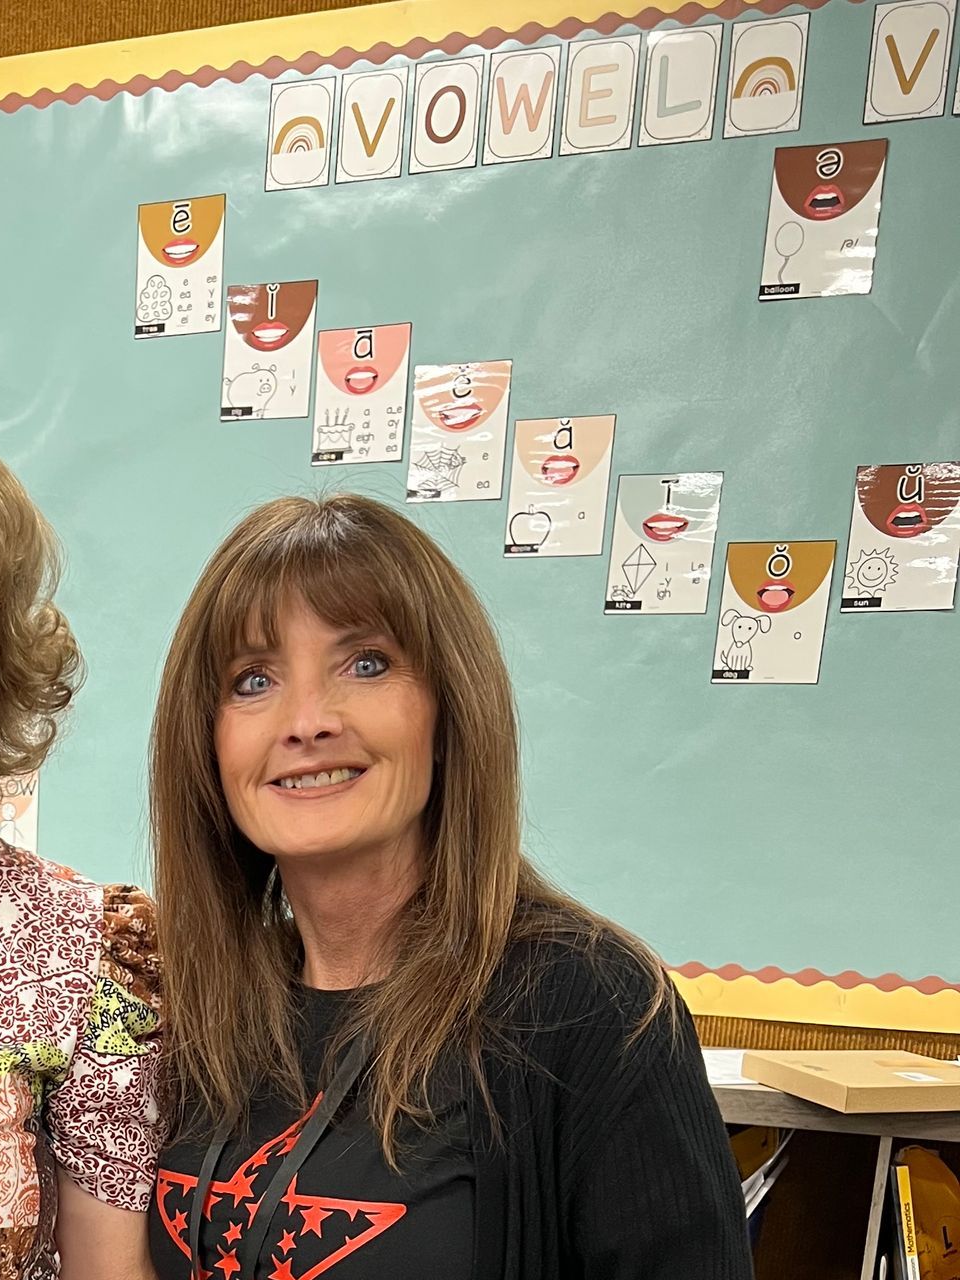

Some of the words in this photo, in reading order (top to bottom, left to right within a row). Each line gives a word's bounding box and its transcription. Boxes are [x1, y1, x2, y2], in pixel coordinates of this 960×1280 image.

[352, 55, 702, 157] VOWEL
[764, 284, 795, 295] balloon
[854, 599, 869, 607] sun
[904, 1202, 917, 1253] Mathematics
